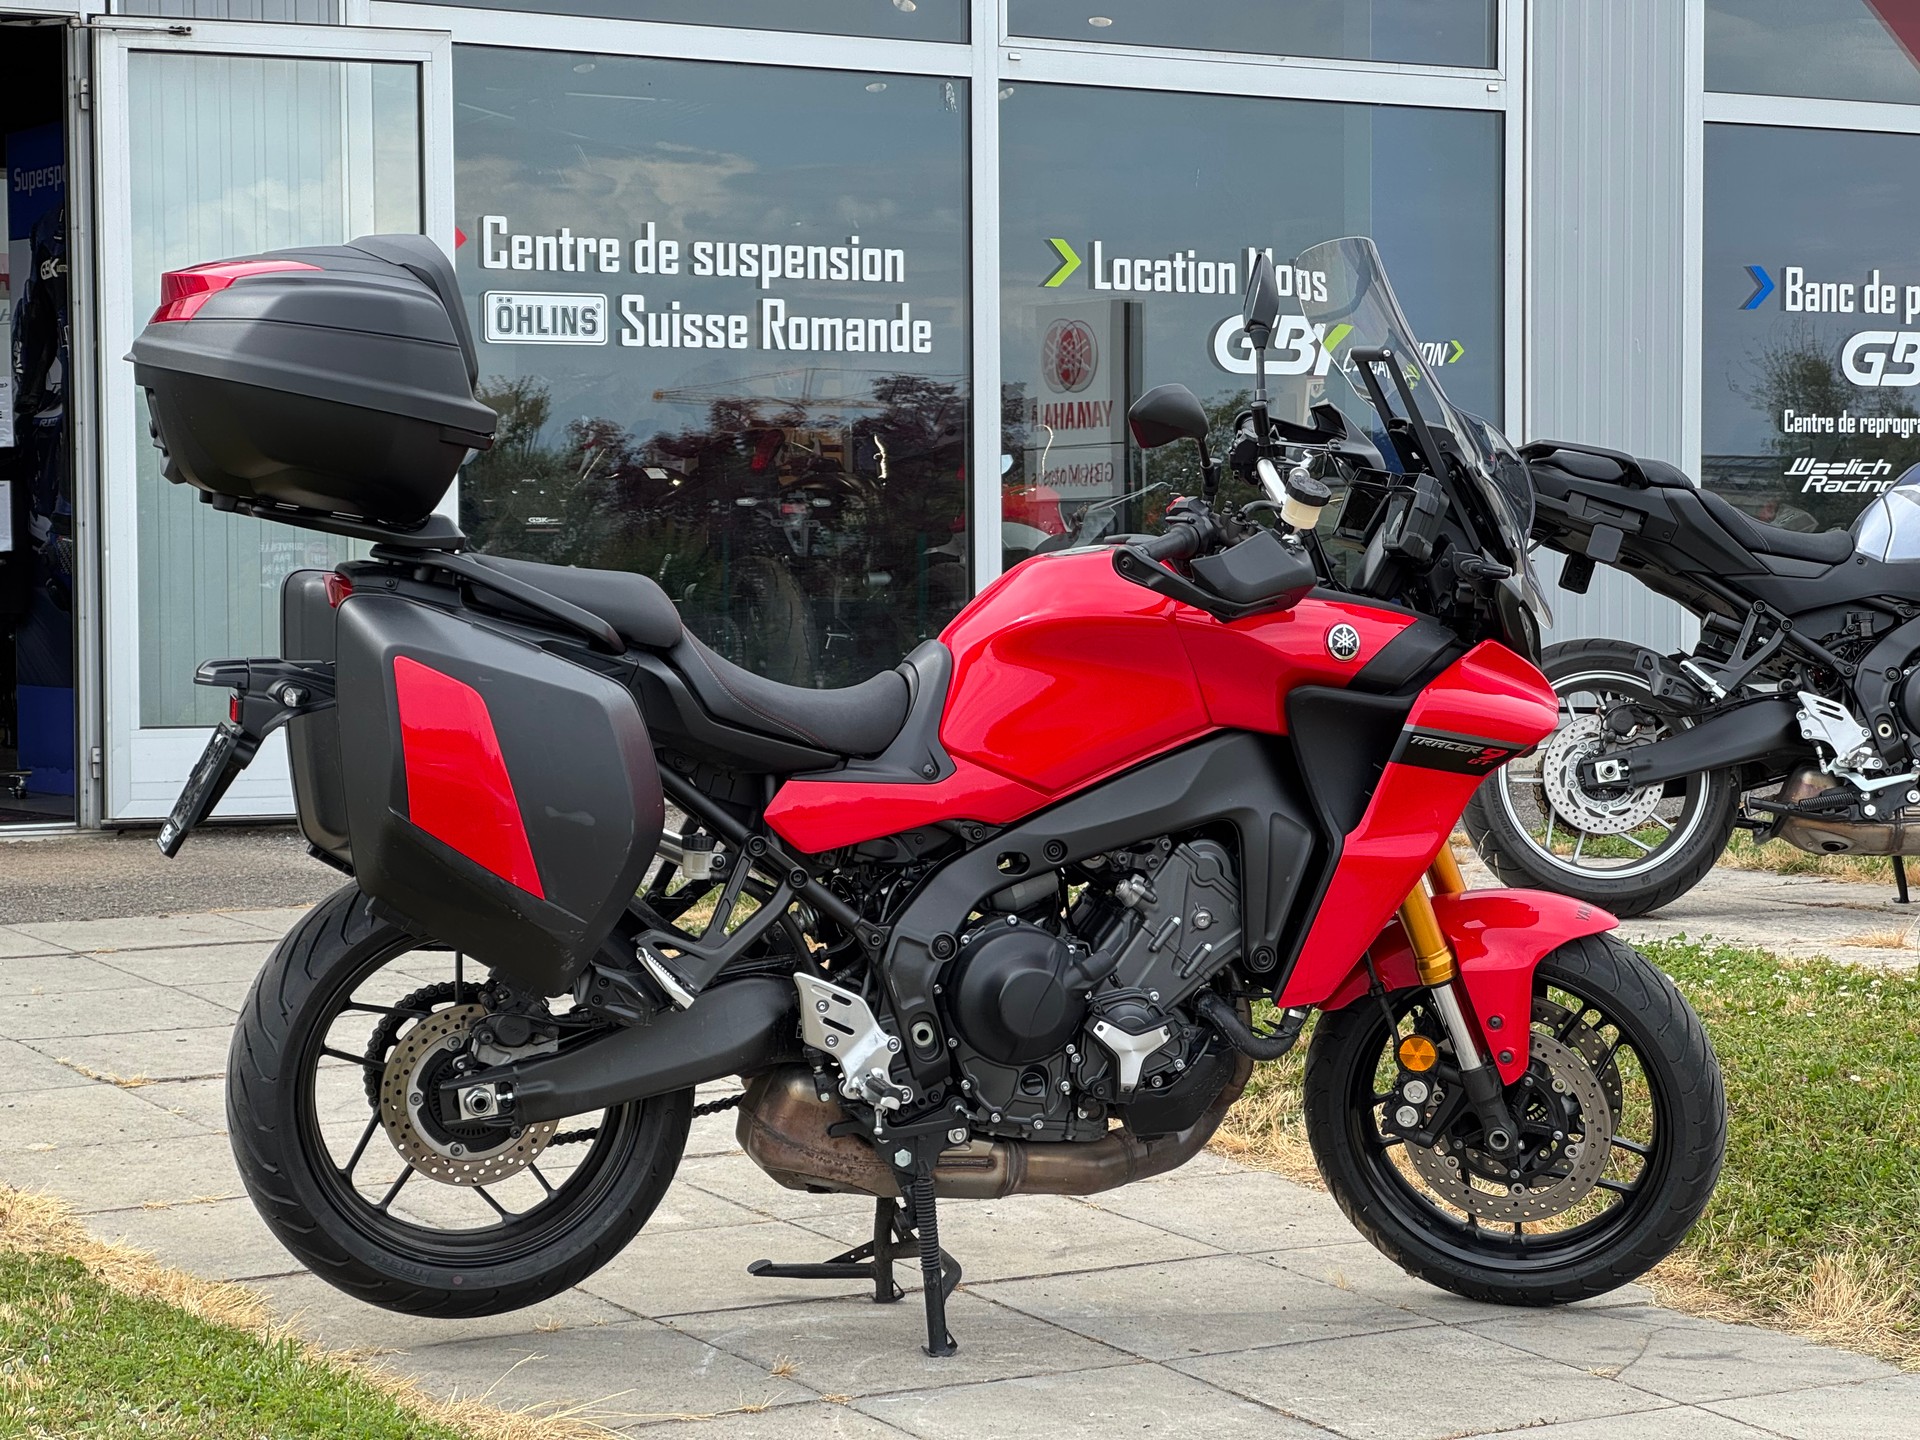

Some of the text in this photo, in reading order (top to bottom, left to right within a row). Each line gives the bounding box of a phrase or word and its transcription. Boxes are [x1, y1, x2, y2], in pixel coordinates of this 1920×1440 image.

[483, 215, 904, 289] Centre de suspension
[1094, 240, 1236, 295] Location
[1785, 266, 1854, 312] Banc
[1864, 269, 1896, 314] de
[495, 296, 598, 336] ÖHLINS
[621, 294, 932, 353] Suisse Romande
[1784, 409, 1834, 433] Centre
[1838, 409, 1856, 434] de
[1783, 457, 1892, 475] Woolich
[1411, 735, 1484, 754] TRACER
[1467, 757, 1493, 766] GT
